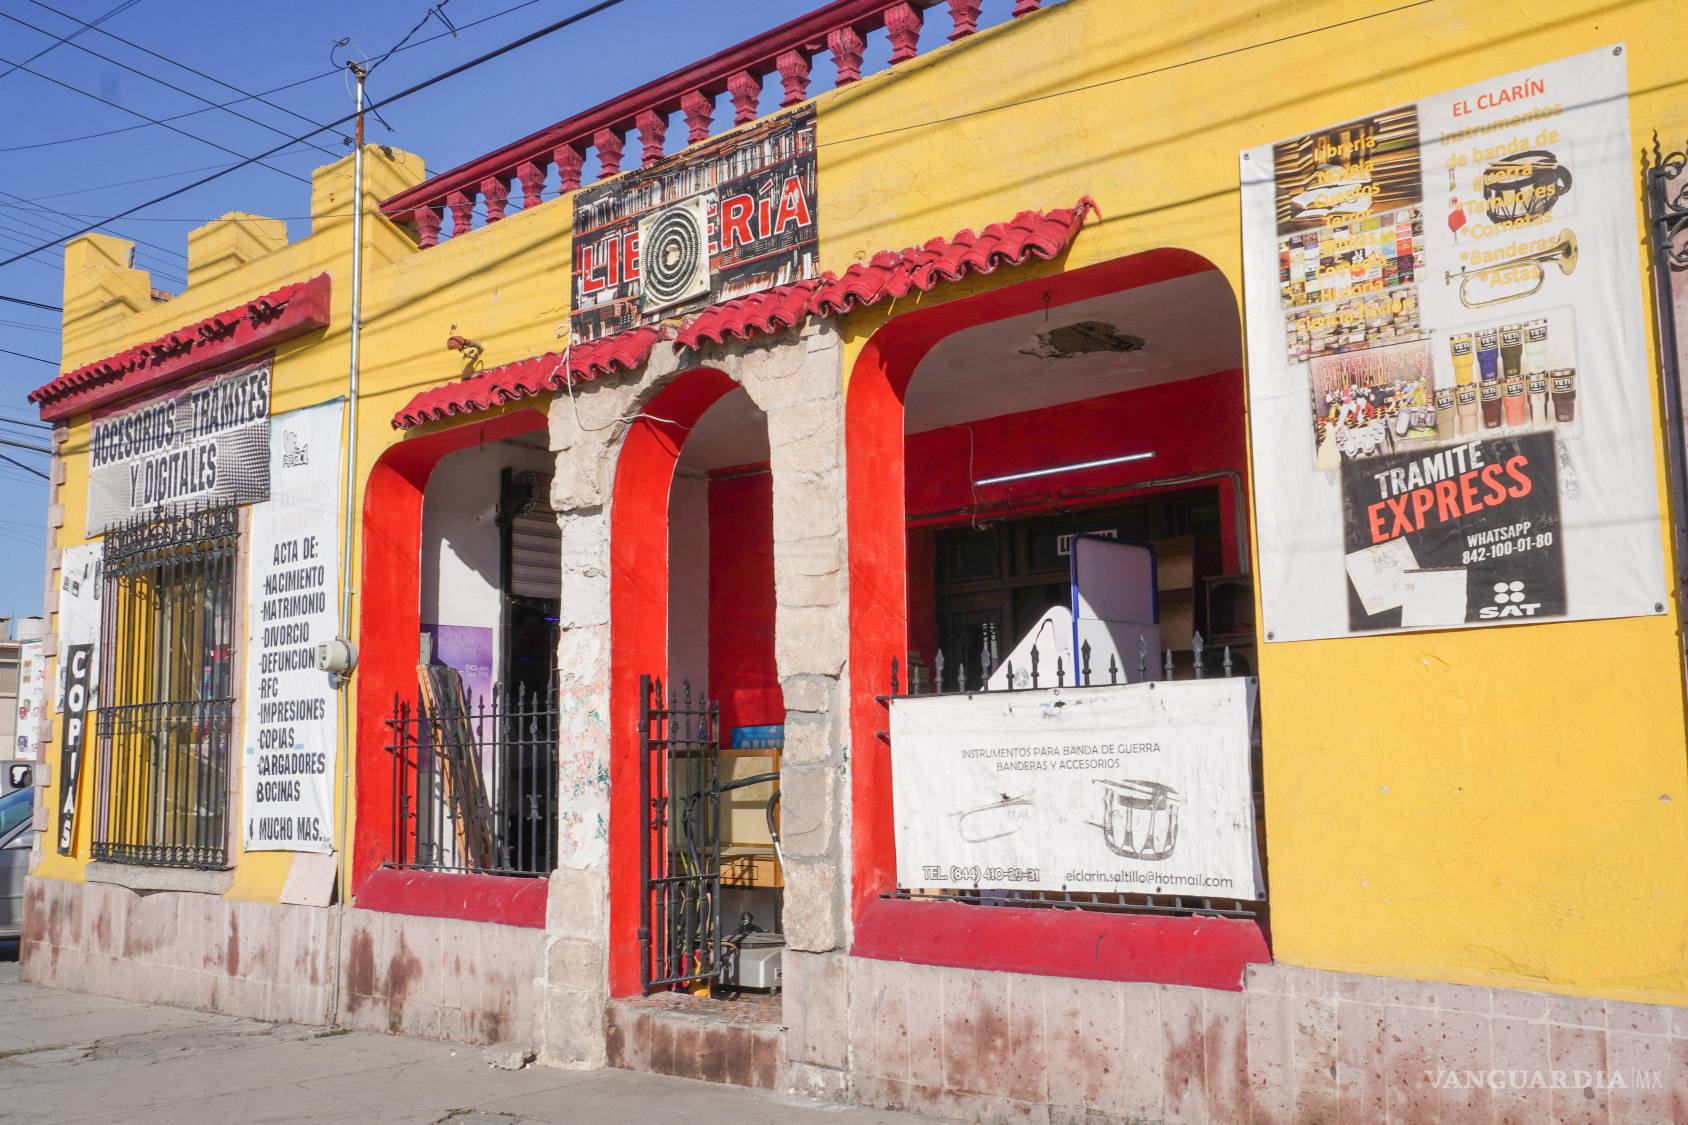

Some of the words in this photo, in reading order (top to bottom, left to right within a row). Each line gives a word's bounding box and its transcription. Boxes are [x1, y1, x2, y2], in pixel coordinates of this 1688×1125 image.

[1452, 100, 1472, 117] EL
[1477, 78, 1545, 110] CLARÍN
[1446, 153, 1468, 169] de
[1472, 136, 1530, 163] banda
[1536, 129, 1560, 147] de
[1473, 164, 1533, 192] guerra
[131, 464, 139, 507] Y
[145, 444, 216, 504] DIGITALES
[1374, 440, 1485, 498] TRAMITE
[1367, 455, 1533, 544] EXPRESS
[1462, 532, 1553, 565] 842-100-01-80
[1467, 522, 1532, 547] WHATSAPP
[273, 539, 298, 566] ACTA
[303, 536, 318, 560] DE:
[1479, 603, 1541, 619] SAT
[61, 650, 87, 849] COPIAS
[961, 747, 1031, 759] INSTRUMENTOS
[1033, 746, 1060, 757] PARA
[1063, 745, 1098, 756] BANDA
[1101, 744, 1115, 755] DE
[1117, 743, 1160, 754] GUERRA
[996, 761, 1048, 771] BANDERAS
[1050, 760, 1056, 769] Y
[1059, 758, 1120, 770] ACCESORIOS
[259, 816, 293, 841] MUCHO
[922, 865, 948, 880] TEL.
[950, 865, 980, 883] (844)
[983, 866, 1041, 882] 410-29-31
[1066, 870, 1233, 888] elclarin.saltillo@hotmail.com
